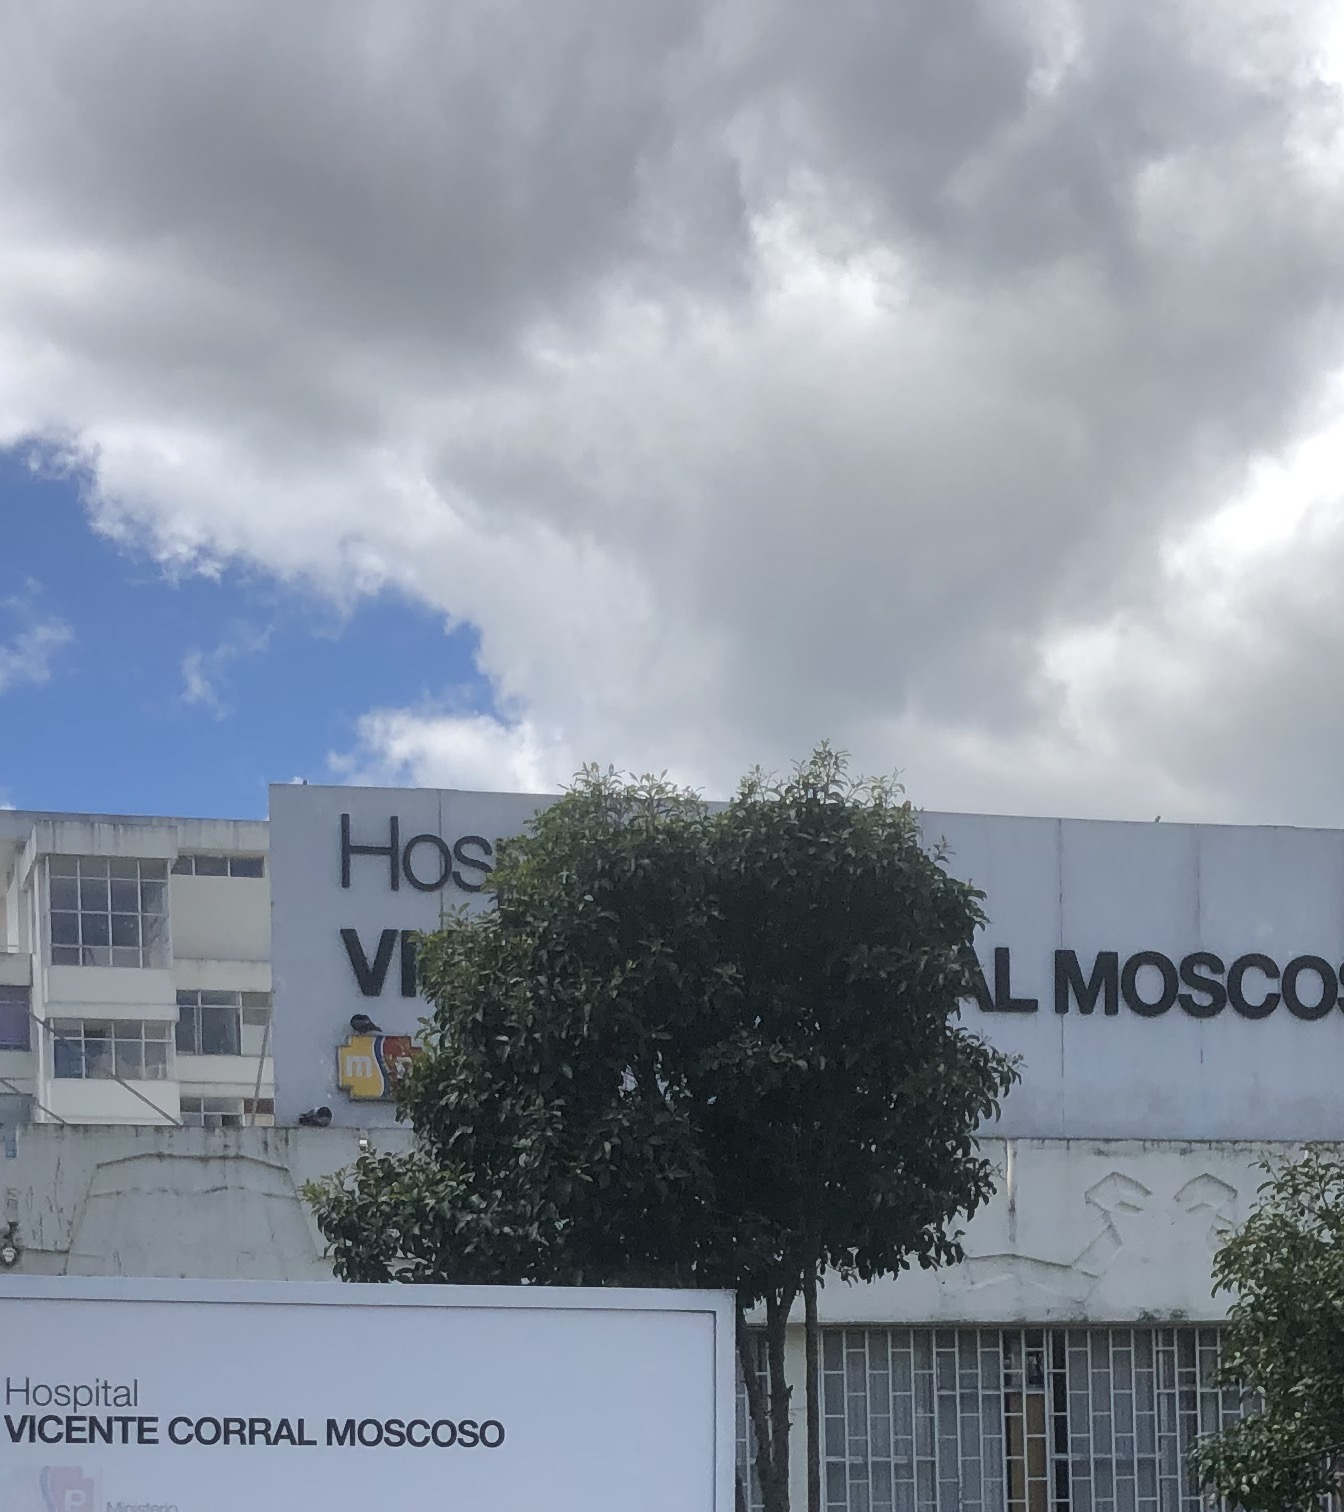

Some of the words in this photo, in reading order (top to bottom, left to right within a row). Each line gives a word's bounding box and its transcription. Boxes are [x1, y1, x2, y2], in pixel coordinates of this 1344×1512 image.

[5, 1376, 138, 1414] Hospital
[4, 1414, 159, 1444] VICENTE
[168, 1416, 317, 1446] CORRAL
[326, 1418, 505, 1448] MOSCOSO
